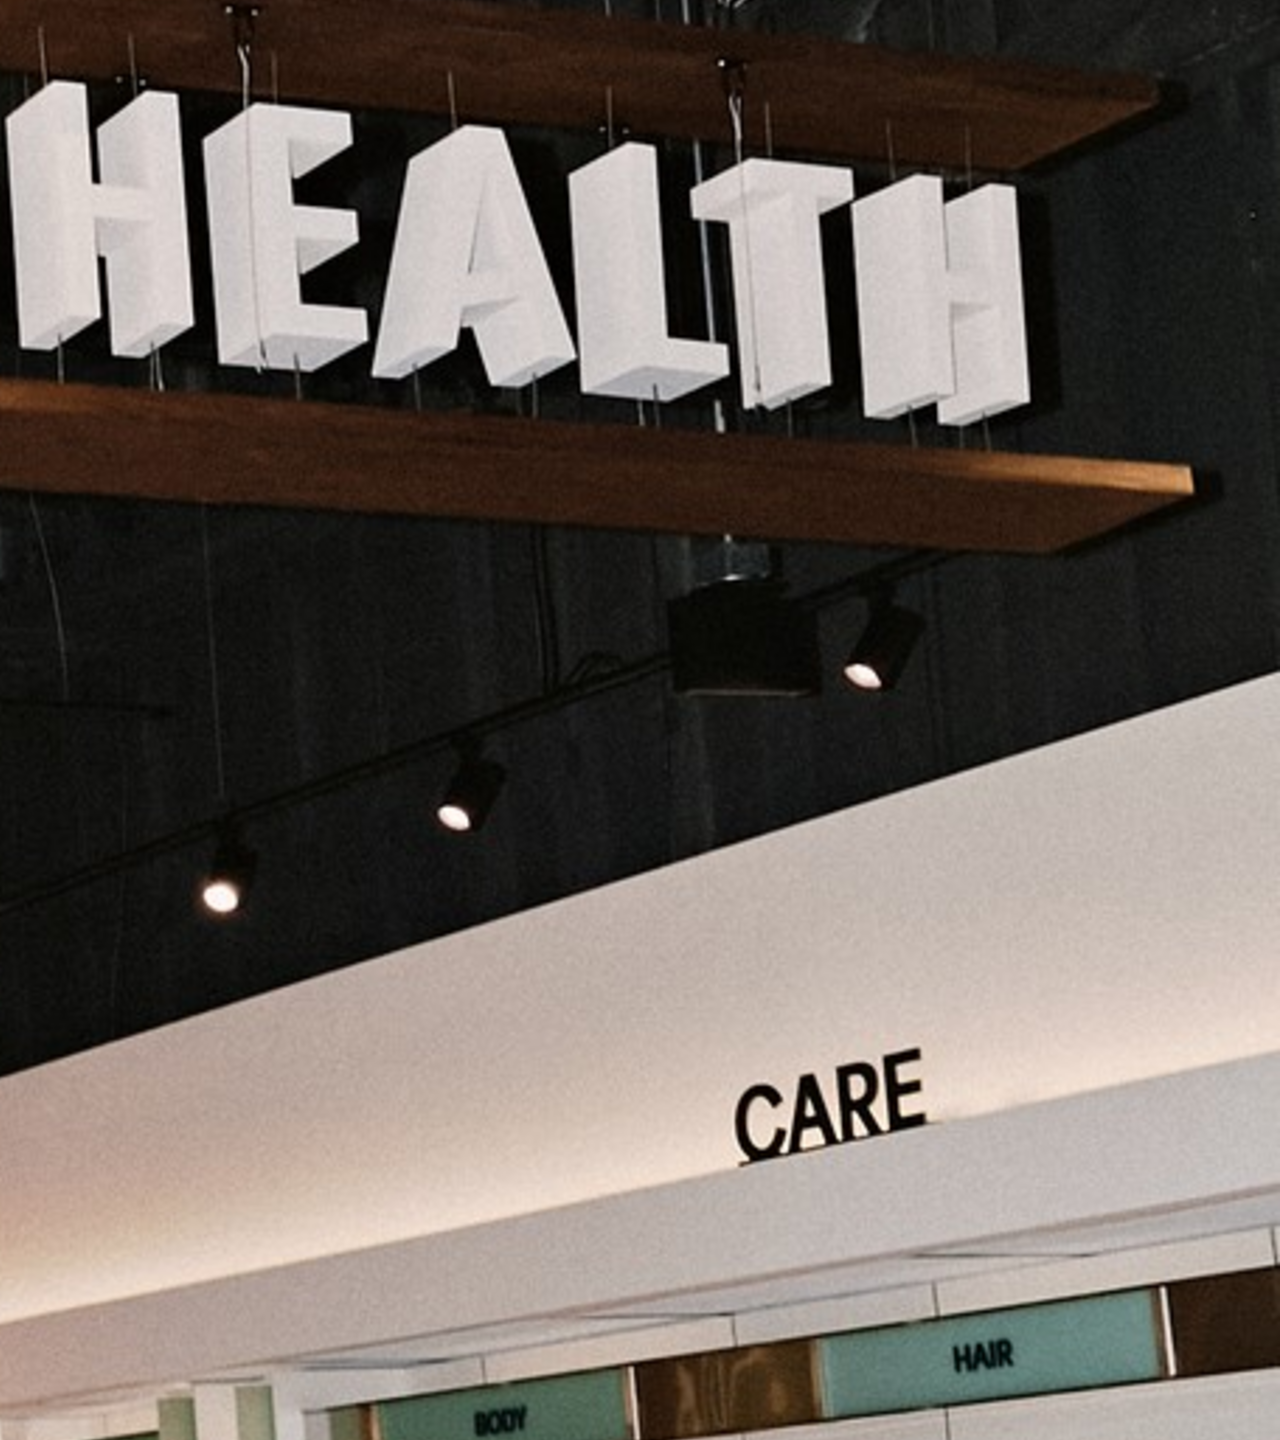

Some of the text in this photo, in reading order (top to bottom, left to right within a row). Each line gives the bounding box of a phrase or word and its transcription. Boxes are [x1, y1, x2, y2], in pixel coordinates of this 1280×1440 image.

[6, 78, 1032, 426] HEALTH
[734, 1047, 927, 1163] CARE
[953, 1337, 1015, 1373] HAIR
[474, 1404, 528, 1437] BODY
